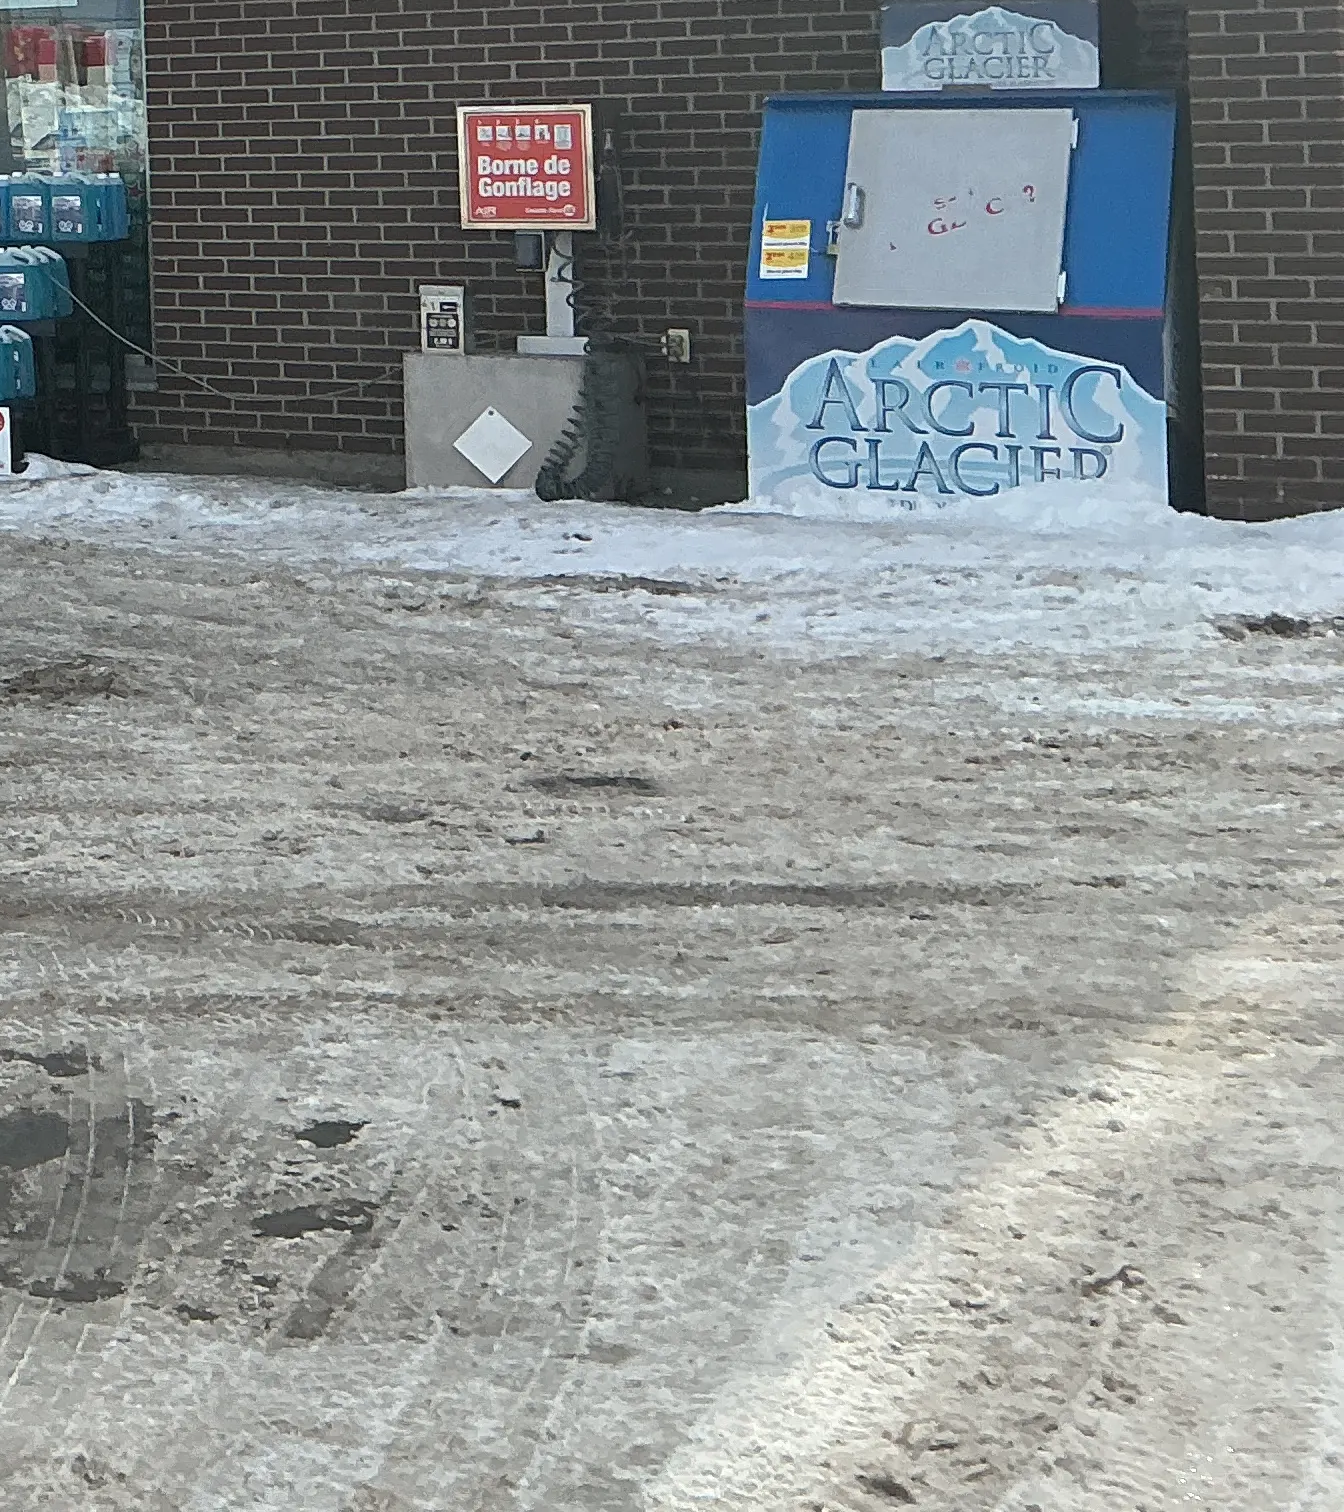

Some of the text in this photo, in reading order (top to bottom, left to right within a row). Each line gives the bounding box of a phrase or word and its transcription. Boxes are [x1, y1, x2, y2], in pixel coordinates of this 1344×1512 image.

[922, 22, 1055, 56] ARCTIC
[923, 55, 1055, 80] GLACIER
[477, 154, 571, 176] Borne de
[478, 176, 571, 201] Gonflage
[806, 357, 1125, 444] ARCTIC
[808, 436, 1108, 497] GLACIER
